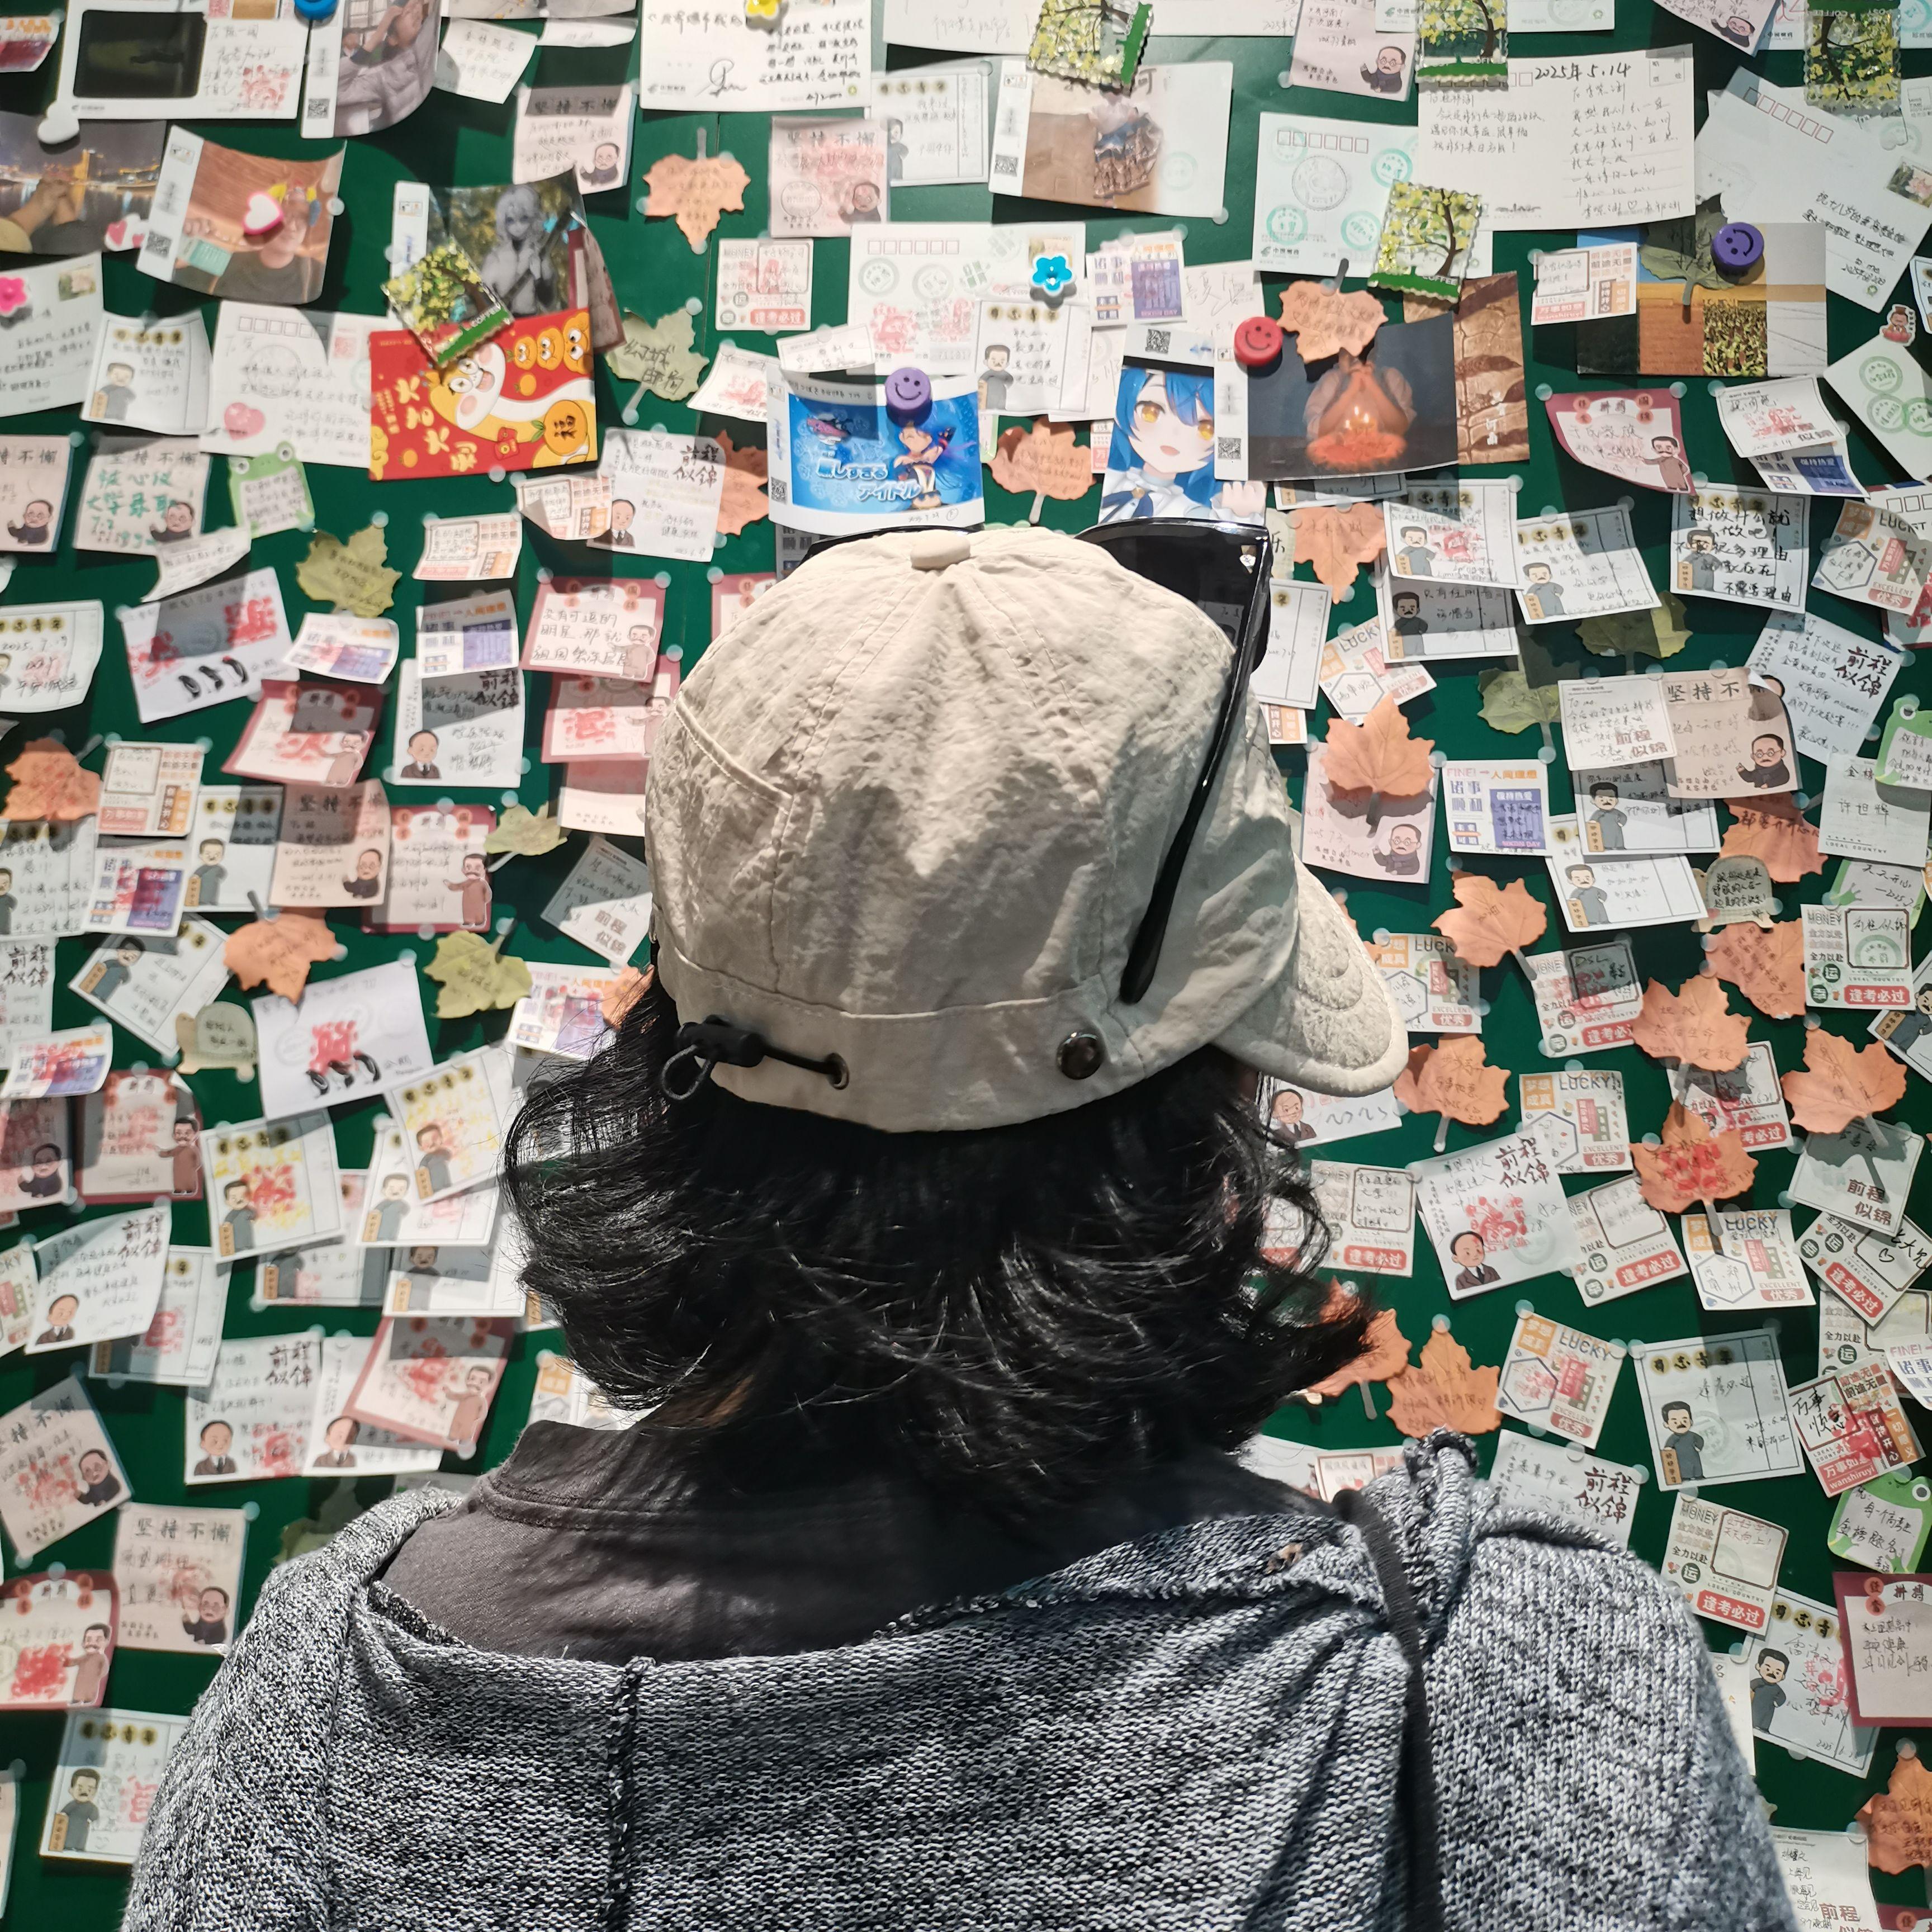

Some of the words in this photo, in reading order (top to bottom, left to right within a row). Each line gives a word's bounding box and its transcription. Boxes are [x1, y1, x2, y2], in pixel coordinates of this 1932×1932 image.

[1535, 62, 1582, 81] 2025年
[1587, 61, 1632, 78] 5.14
[553, 414, 576, 441] 福
[858, 479, 921, 501] アイドル
[1688, 506, 1791, 526] 想做什么就
[1847, 646, 1892, 676] 前程
[1668, 681, 1740, 703] 坚持不
[1834, 664, 1882, 699] 似锦
[1447, 768, 1476, 777] FINE!
[1862, 863, 1912, 889] 天天开心
[1807, 909, 1843, 926] MONEY
[1810, 951, 1844, 963] 全力以赴
[1849, 988, 1906, 1003] 逢考必过
[1439, 1013, 1466, 1026] 优秀
[1559, 1077, 1612, 1091] LUCKY
[1741, 1125, 1782, 1143] 考必过
[1494, 1135, 1542, 1171] 前程
[1583, 1144, 1625, 1153] EXCELLENT
[1591, 1153, 1620, 1166] 优秀
[1499, 1161, 1551, 1190] 似锦
[1847, 1178, 1886, 1204] 前程
[1725, 1215, 1778, 1231] LUCKY
[1854, 1200, 1892, 1226] 似锦
[1825, 1214, 1857, 1244] 全力以赴
[1621, 1254, 1675, 1284] 逢考必过
[1769, 1289, 1799, 1301] 优秀
[1829, 1267, 1879, 1315] 逢考必过
[1559, 1330, 1609, 1361] LUCKY
[1824, 1330, 1862, 1343] 全力以赴
[1890, 1343, 1922, 1358] FINE!
[1792, 1385, 1827, 1417] 万事
[1554, 1404, 1595, 1424] EXCELLENT
[1869, 1413, 1900, 1462] 保持开心
[1584, 1465, 1634, 1496] 前程
[1829, 1464, 1876, 1490] wanshiruyi
[1574, 1490, 1627, 1525] 似锦
[1679, 1502, 1720, 1526] MONEY
[134, 1517, 233, 1543] 坚持不懈
[1672, 1545, 1709, 1565] 全力以赴
[1683, 1565, 1698, 1581] 运
[1702, 1595, 1760, 1625] 逢考必过
[1819, 1902, 1861, 1923] 前程
